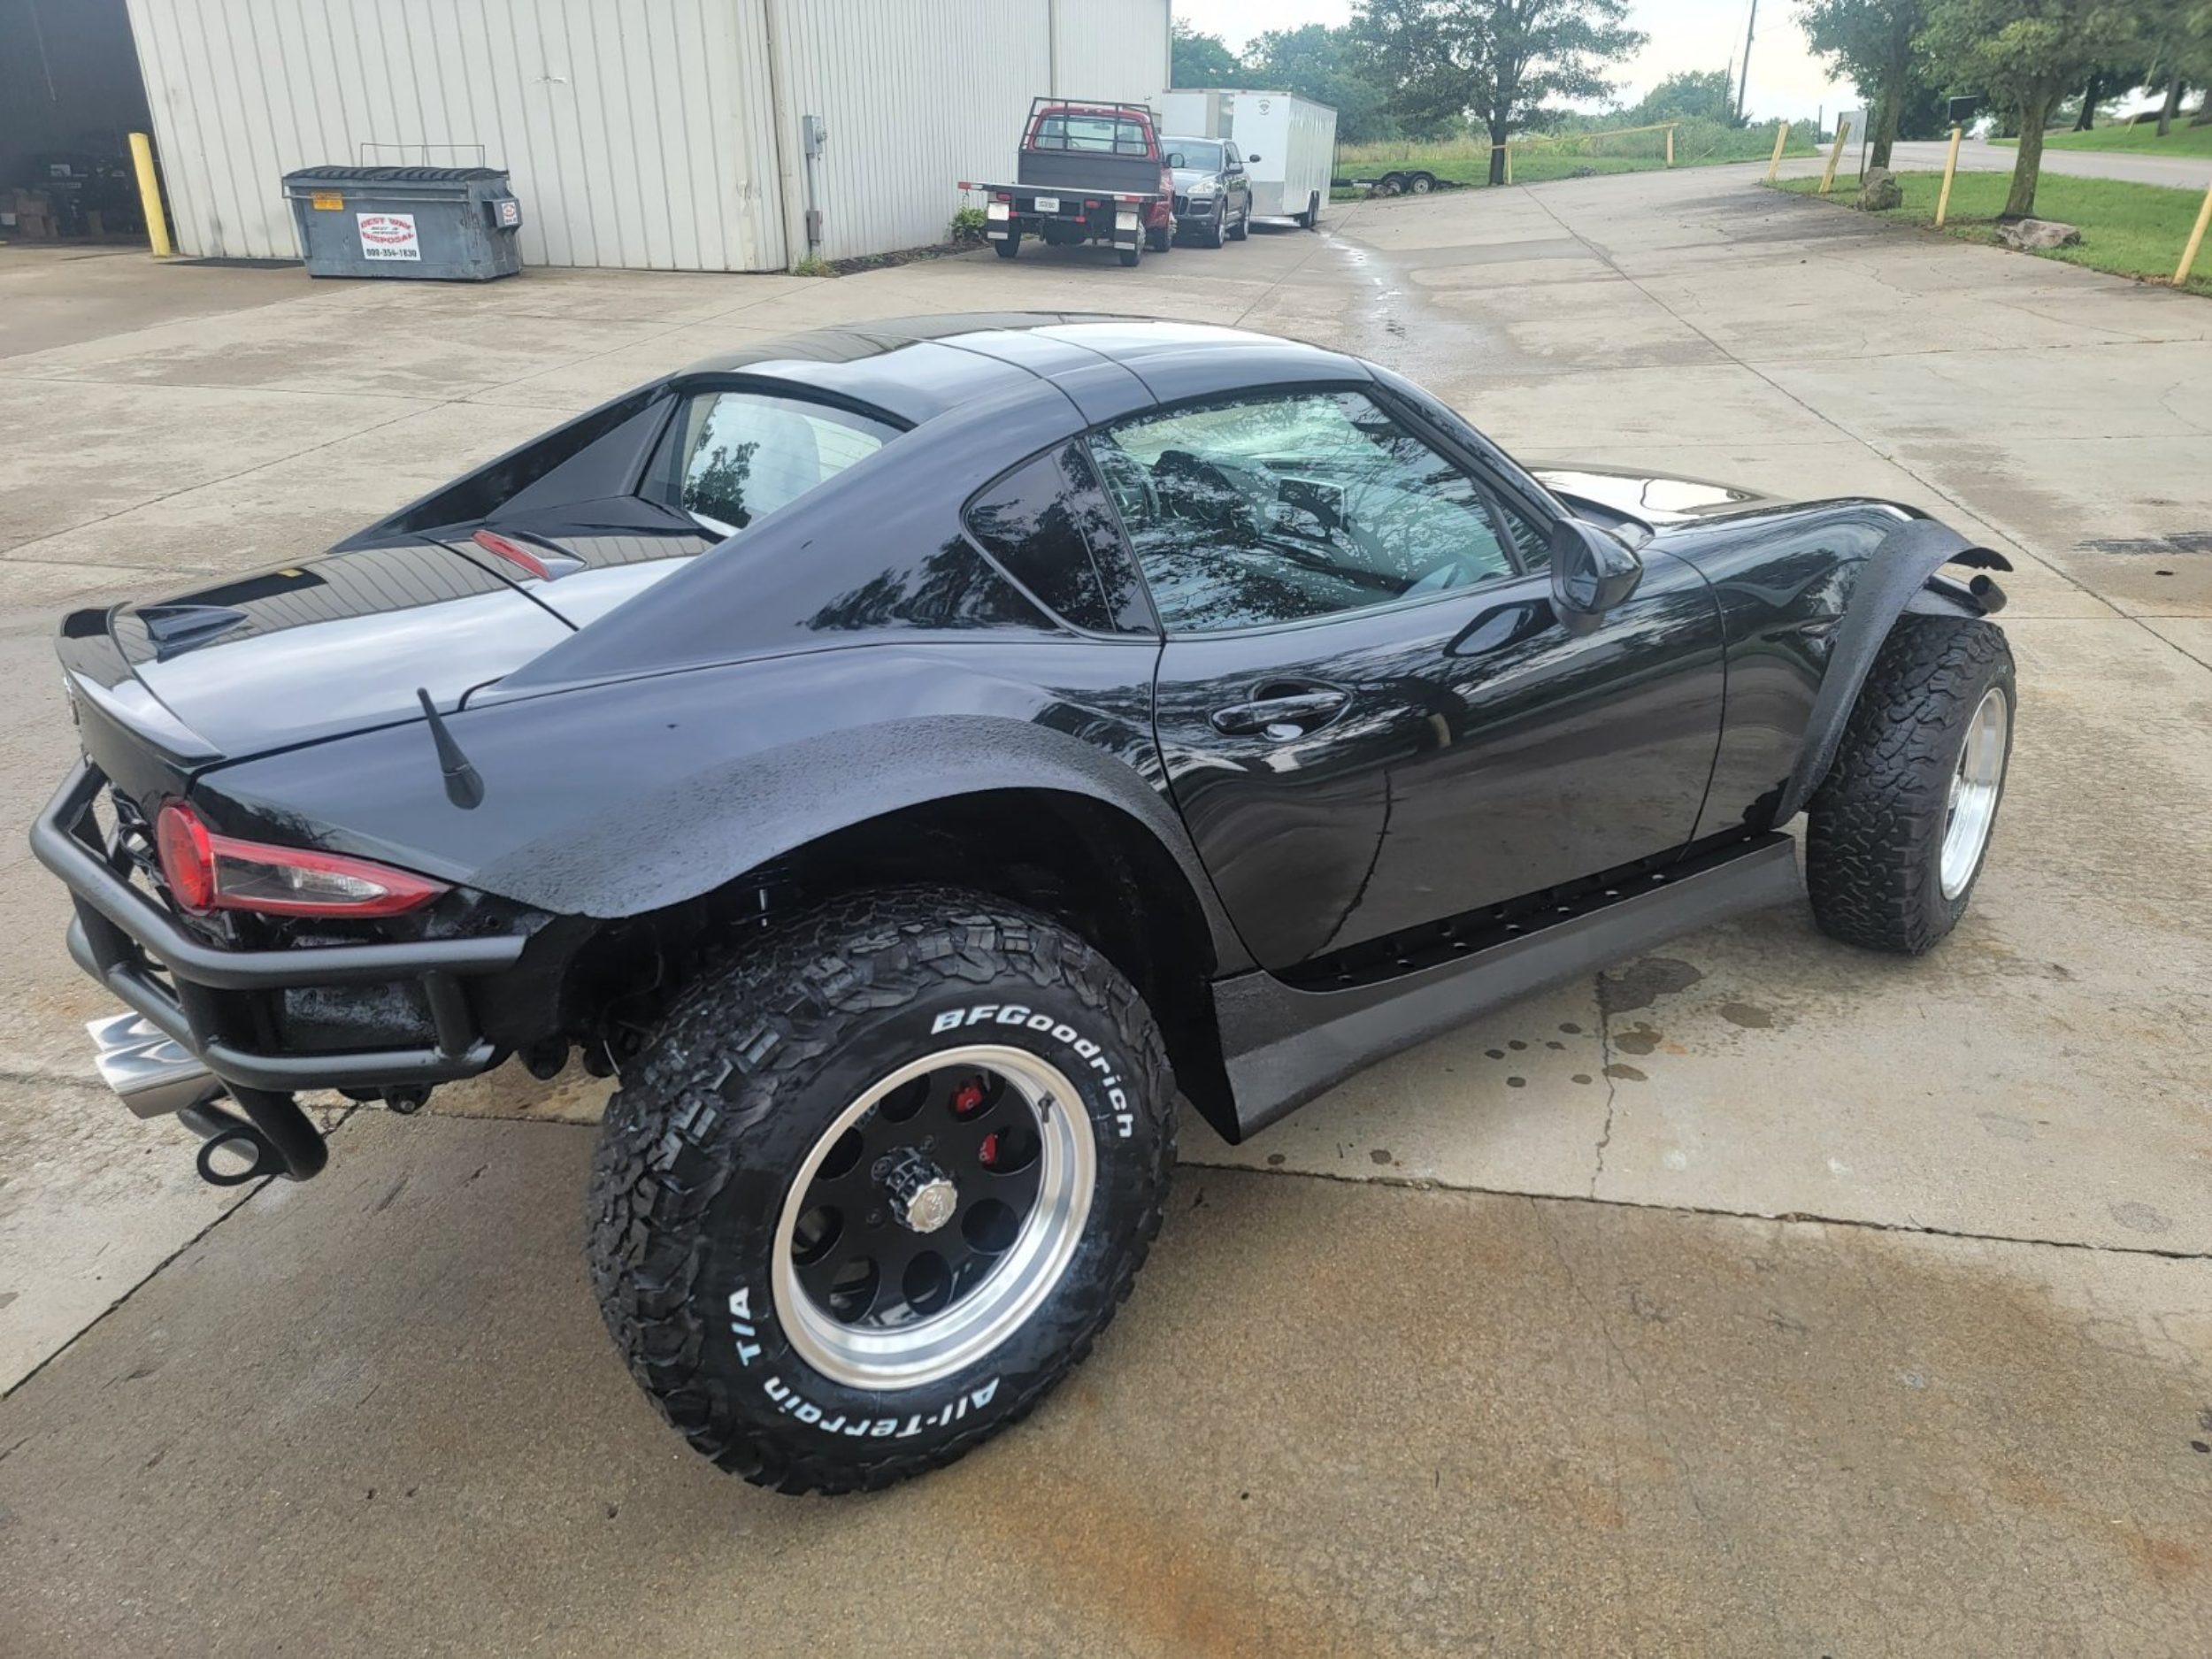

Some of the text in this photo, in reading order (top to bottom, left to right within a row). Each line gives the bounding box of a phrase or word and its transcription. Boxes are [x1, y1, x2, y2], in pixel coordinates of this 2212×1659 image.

[362, 231, 415, 244] DISPOSAL
[931, 1004, 1133, 1139] BFGoodrich
[728, 1286, 1000, 1438] All-Terrain T/A
